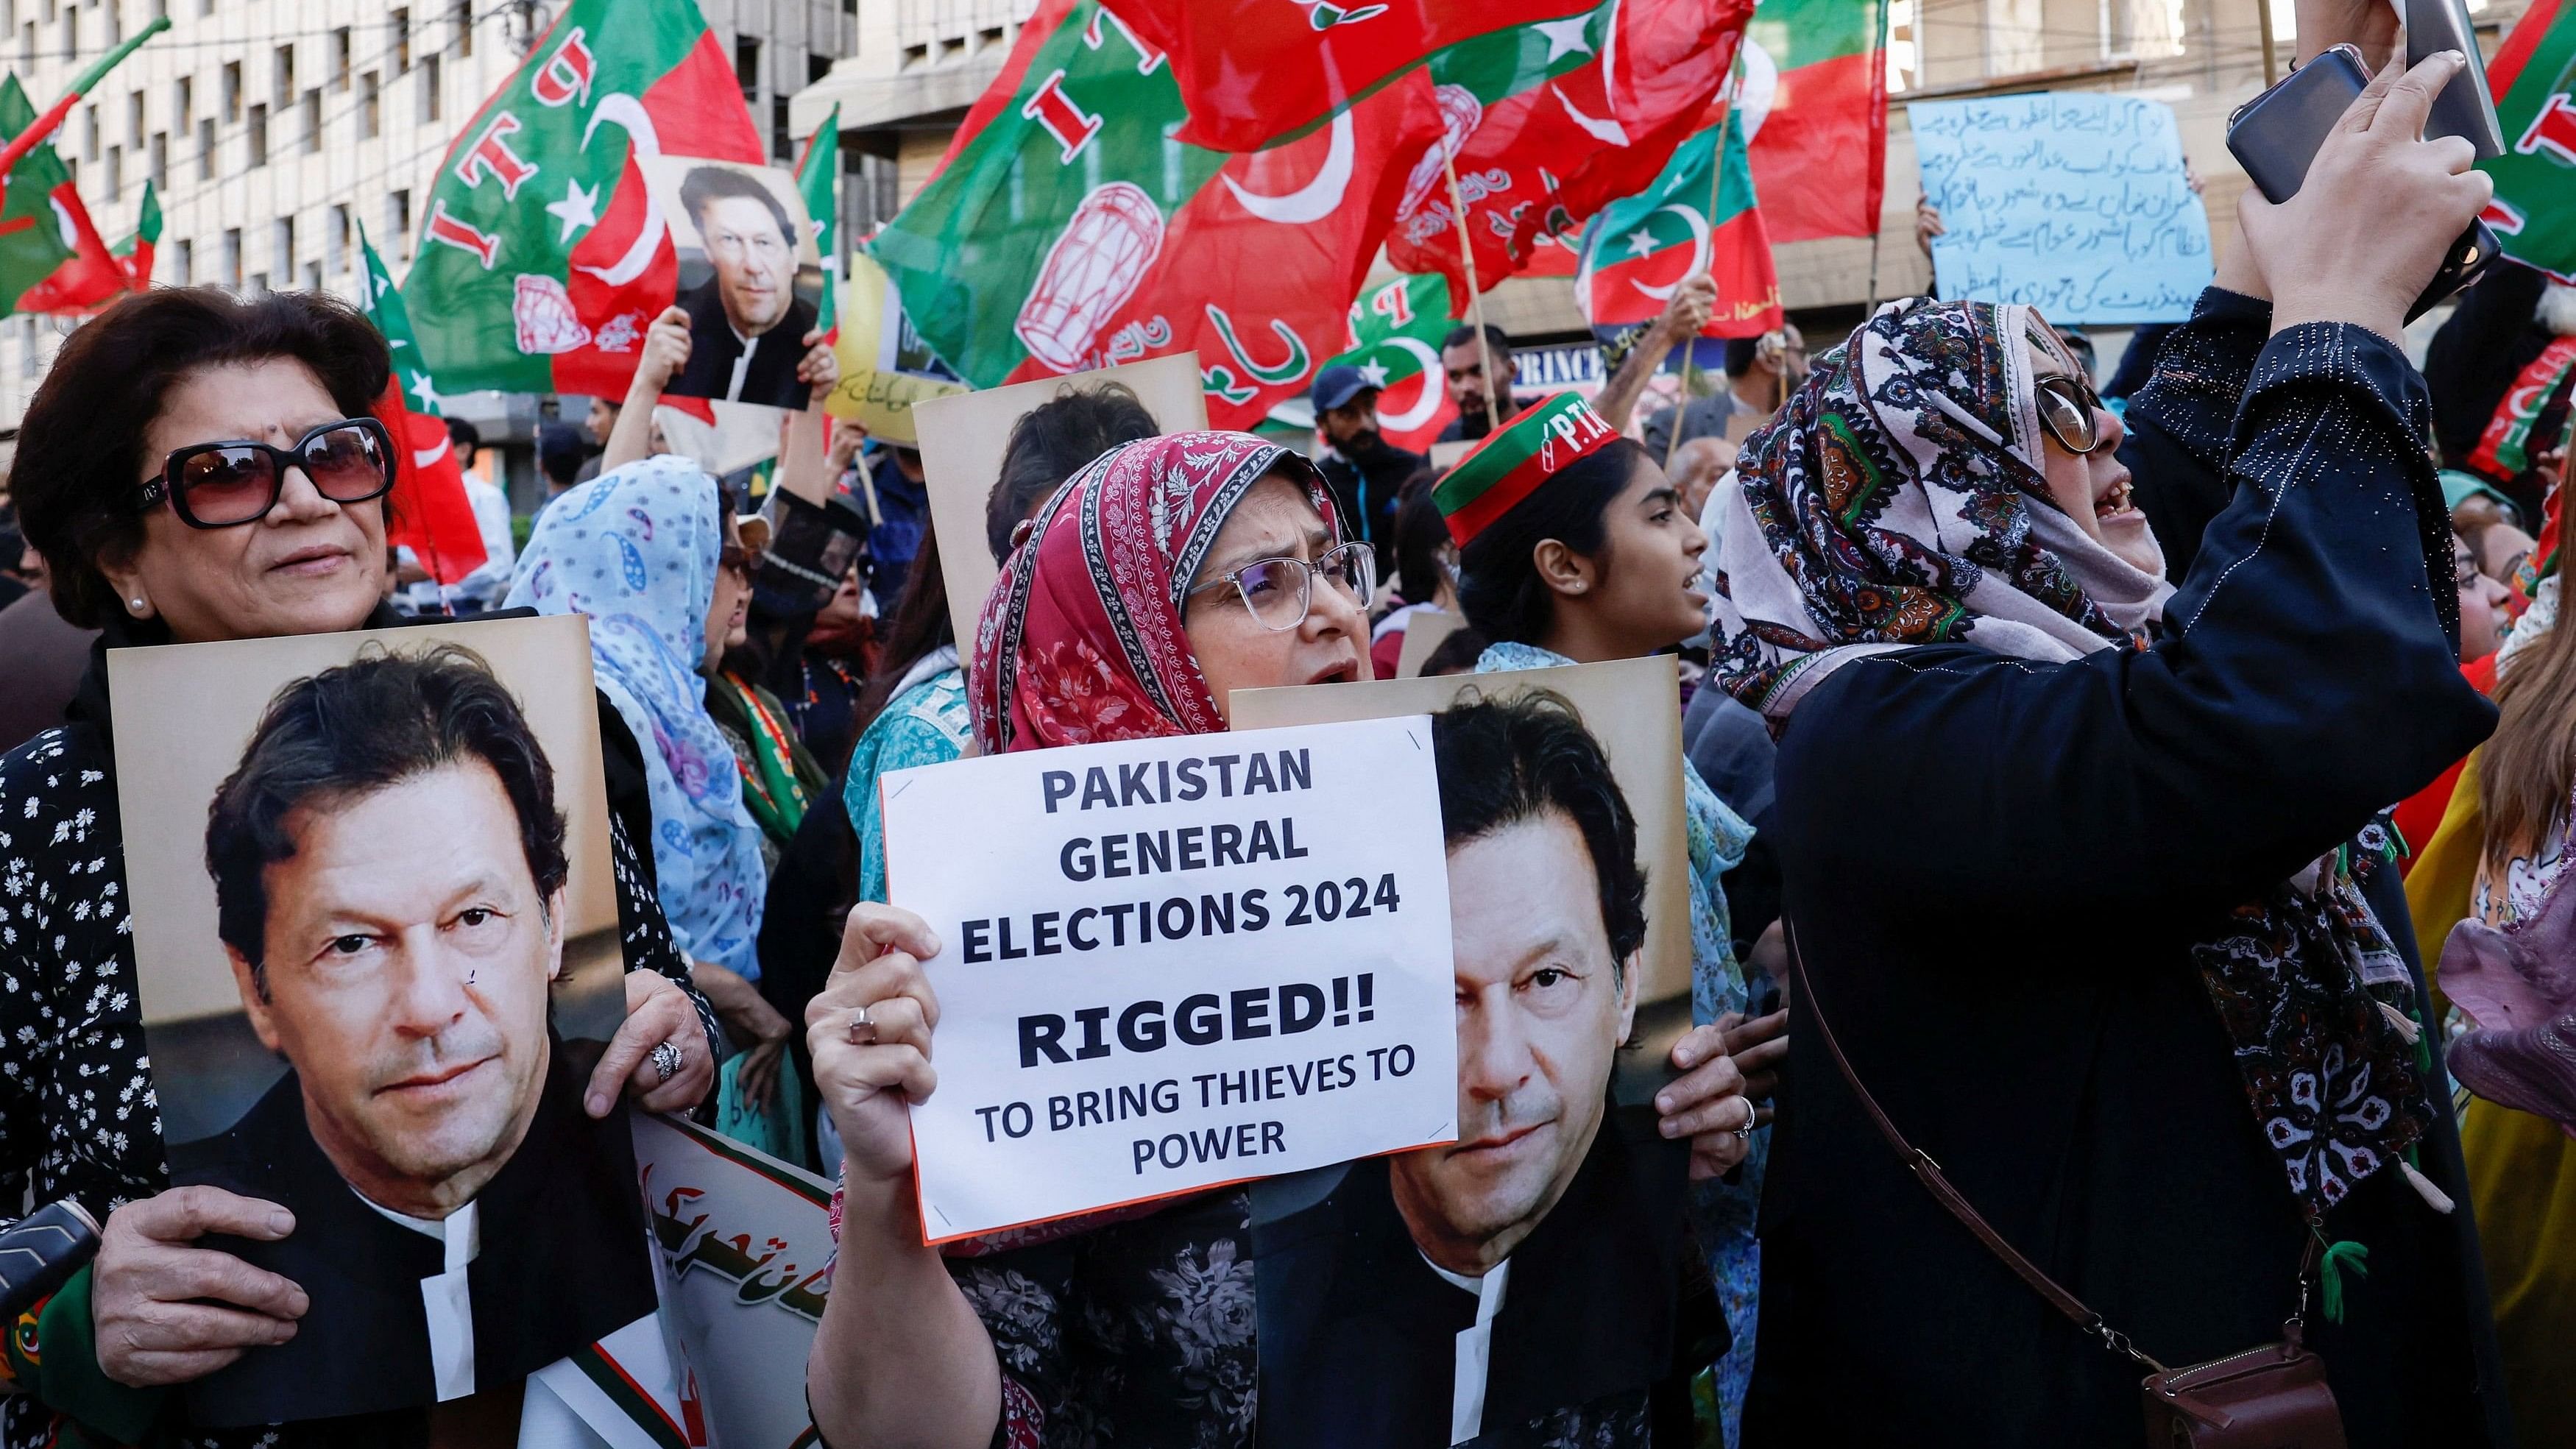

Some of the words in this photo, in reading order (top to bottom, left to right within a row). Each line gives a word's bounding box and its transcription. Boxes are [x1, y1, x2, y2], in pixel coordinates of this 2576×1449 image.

[1042, 748, 1311, 813] PAKISTAN
[1061, 818, 1308, 882] GENERAL
[962, 889, 1270, 964] ELECTIONS
[1284, 874, 1400, 927] 2024
[1019, 973, 1373, 1068] RIGGED!!
[975, 1102, 1033, 1142] TO
[1049, 1080, 1178, 1131] BRING
[1192, 1055, 1356, 1108] THIEVES
[1367, 1044, 1415, 1080] TO
[1133, 1122, 1286, 1175] POWER
